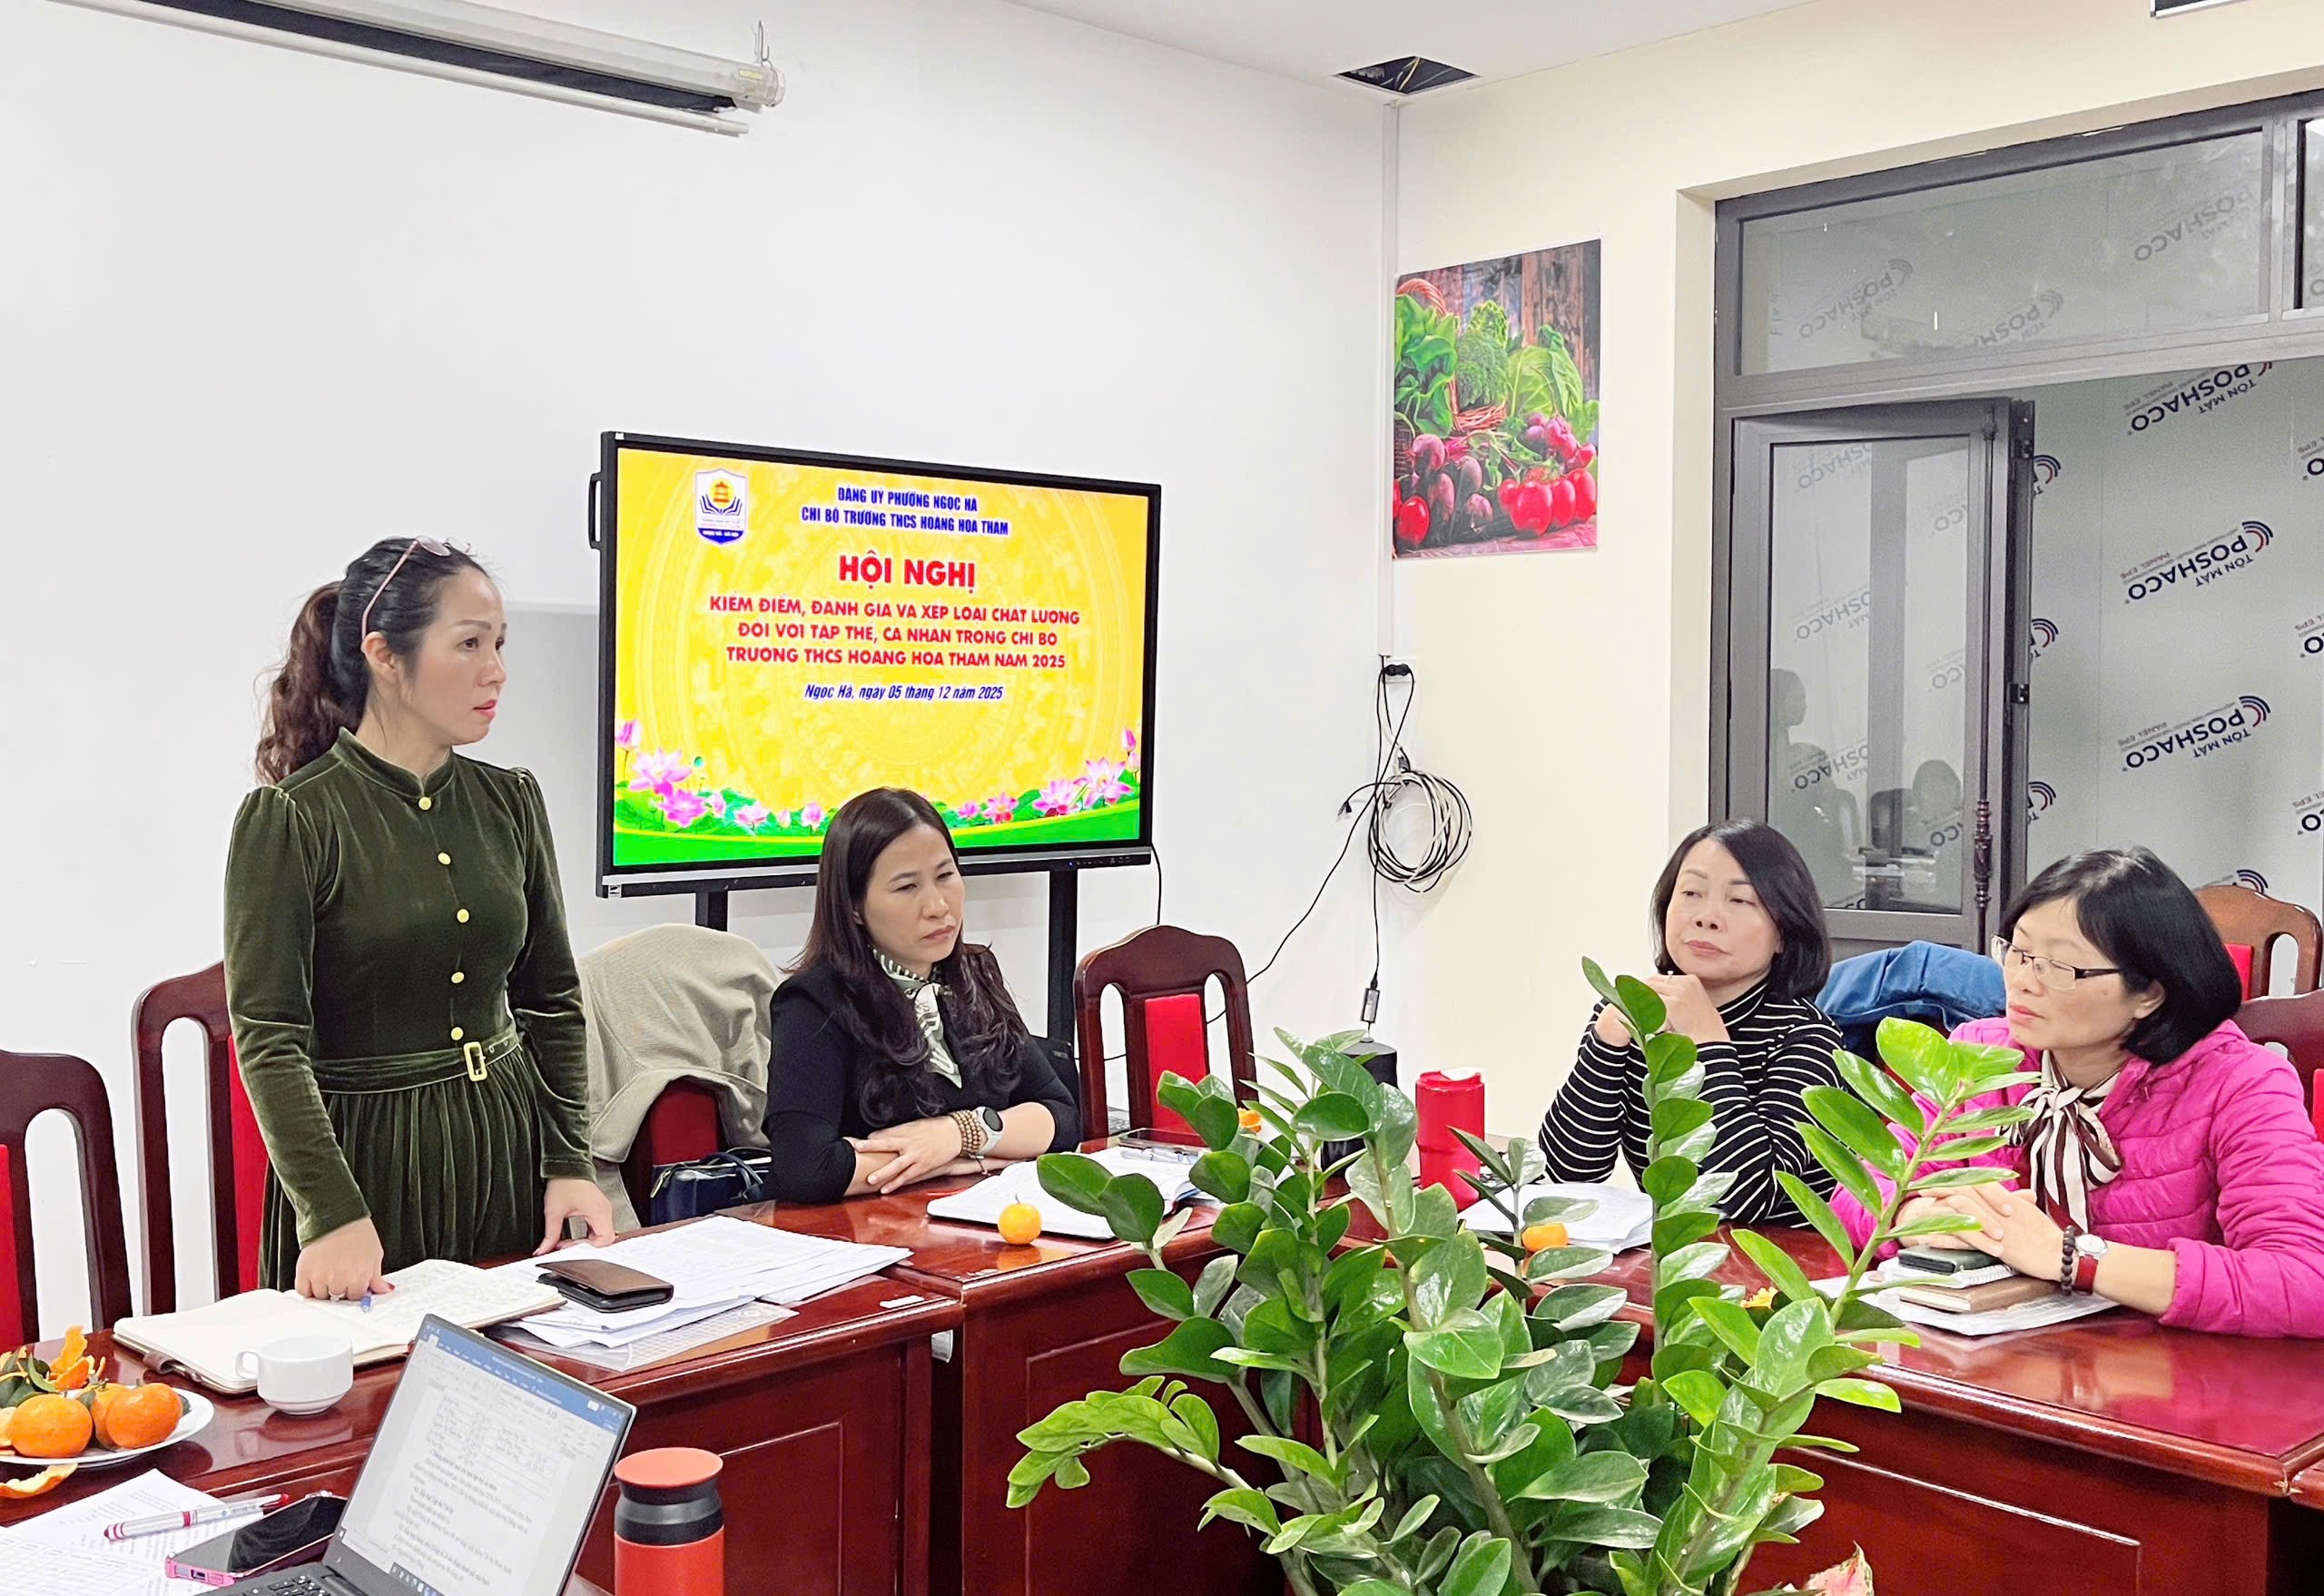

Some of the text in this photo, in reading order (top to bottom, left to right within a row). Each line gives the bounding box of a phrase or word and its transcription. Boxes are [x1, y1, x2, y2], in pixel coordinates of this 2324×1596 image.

[802, 507, 820, 521] CHI
[891, 514, 916, 528] THCS
[840, 549, 975, 594] HỘI NGHỊ
[2128, 535, 2249, 600] POSHACO
[956, 629, 1006, 645] TRONG
[1011, 632, 1033, 645] CHI
[804, 648, 842, 664] THCS
[911, 651, 944, 665] HOA
[1032, 655, 1066, 668] 2025
[888, 685, 902, 699] 05
[939, 686, 950, 699] 12
[978, 686, 1003, 699] 2025
[2126, 708, 2245, 768] POSHACO
